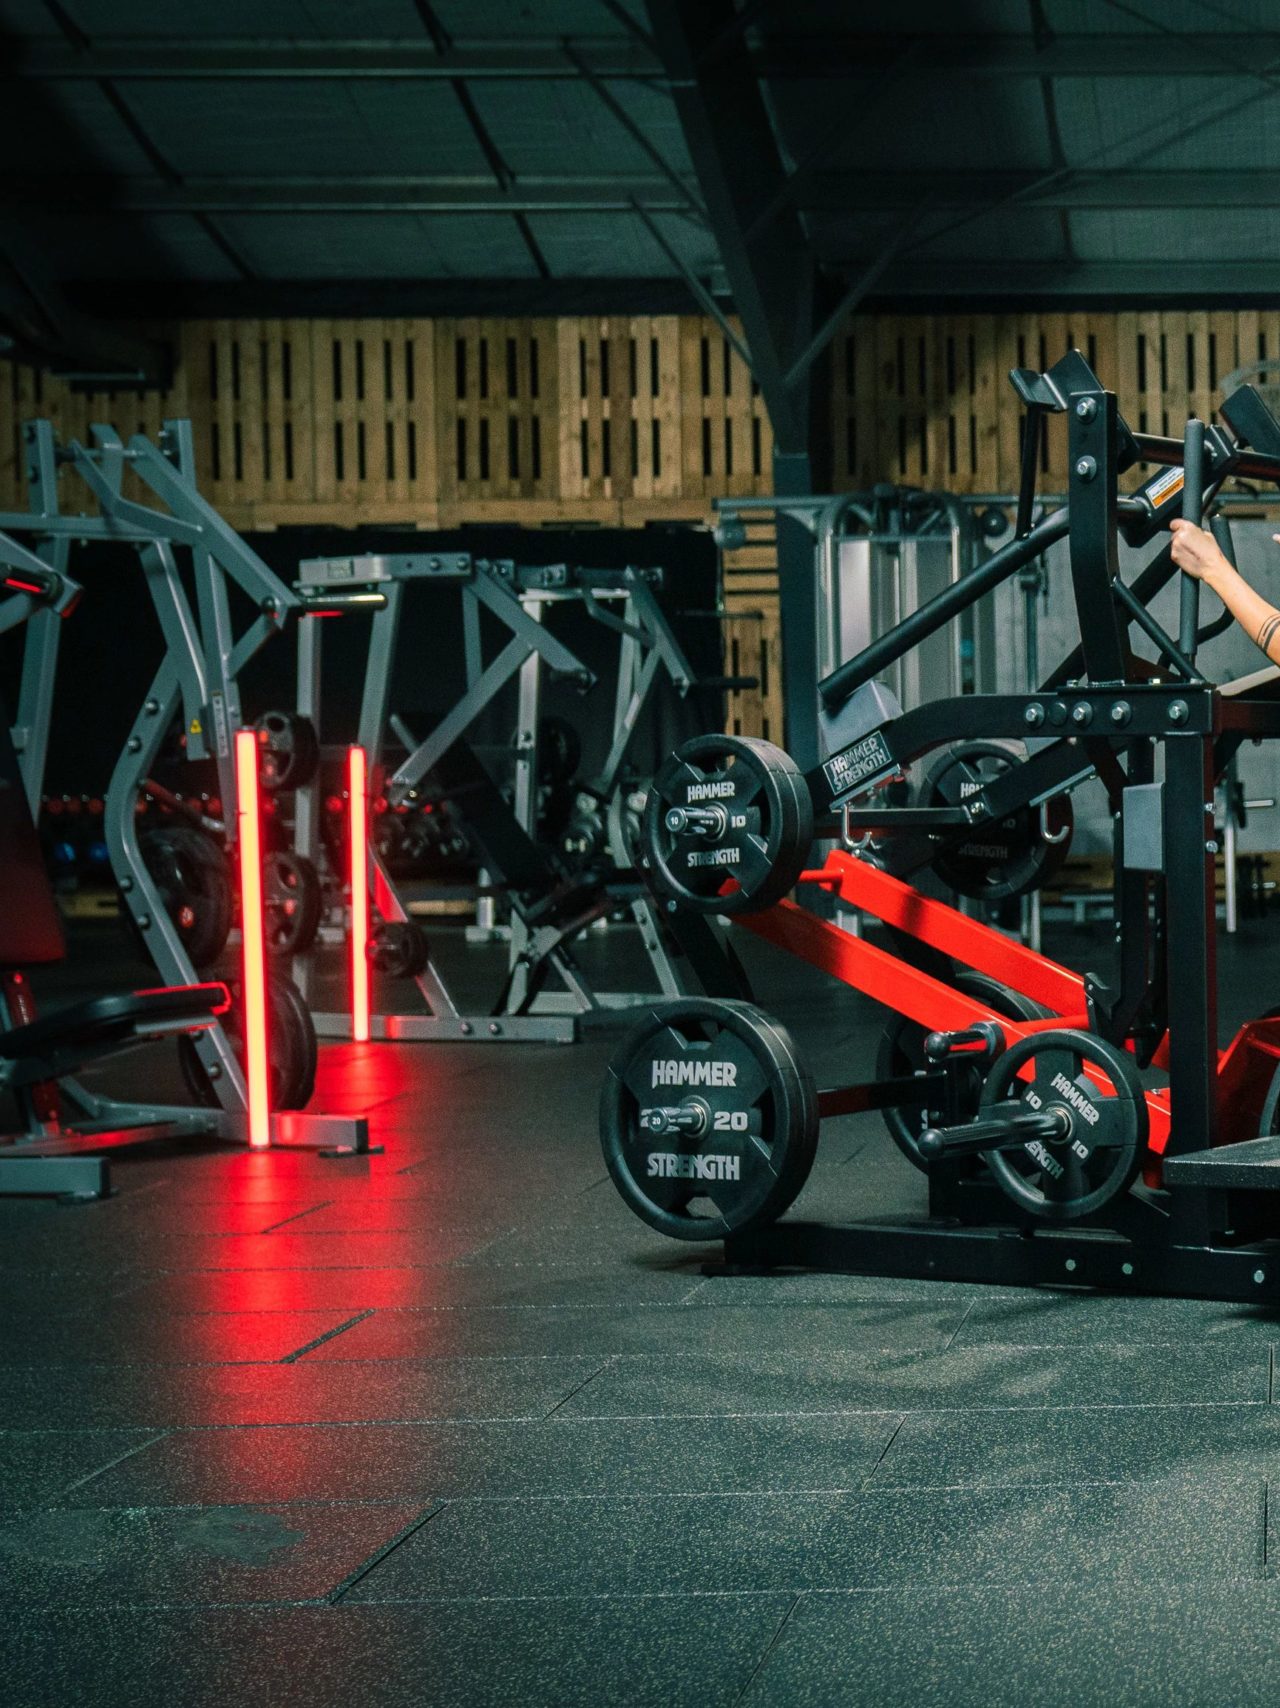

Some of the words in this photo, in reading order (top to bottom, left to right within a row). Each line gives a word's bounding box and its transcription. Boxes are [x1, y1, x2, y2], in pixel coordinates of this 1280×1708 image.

[829, 737, 879, 776] HAMMER
[834, 749, 887, 790] STRENGTH
[687, 781, 736, 803] HAMMER
[670, 816, 679, 825] 10
[731, 815, 746, 828] 10
[687, 848, 740, 867] STRENGTH
[652, 1060, 737, 1089] HAMMER
[1025, 1090, 1043, 1110] 10
[1050, 1072, 1100, 1126] HAMMER
[652, 1117, 661, 1125] 20
[714, 1111, 748, 1131] 20
[1071, 1140, 1089, 1159] 10
[647, 1152, 741, 1181] STRENGTH
